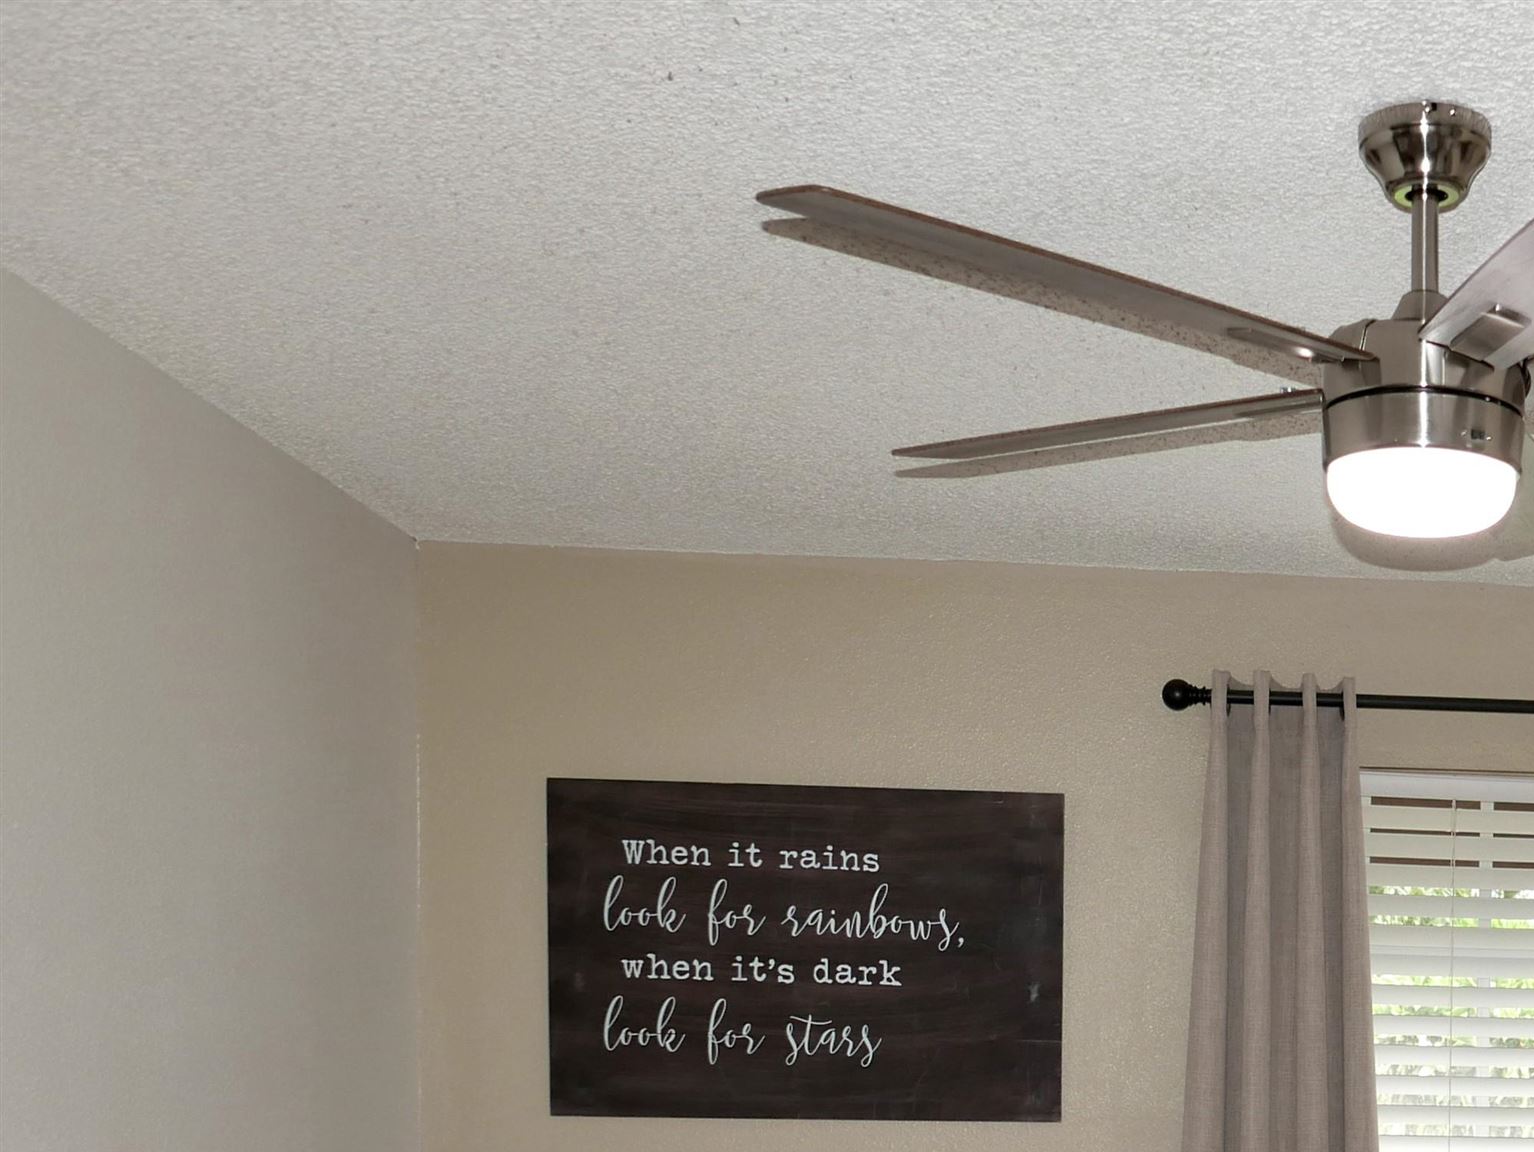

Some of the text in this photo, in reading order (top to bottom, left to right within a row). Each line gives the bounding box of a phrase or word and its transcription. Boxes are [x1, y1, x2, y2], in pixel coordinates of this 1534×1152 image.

[622, 839, 880, 873] When it rains
[602, 874, 965, 951] look for rainbows,
[621, 953, 714, 982] when
[813, 959, 902, 987] dark
[602, 994, 883, 1068] look for stars
